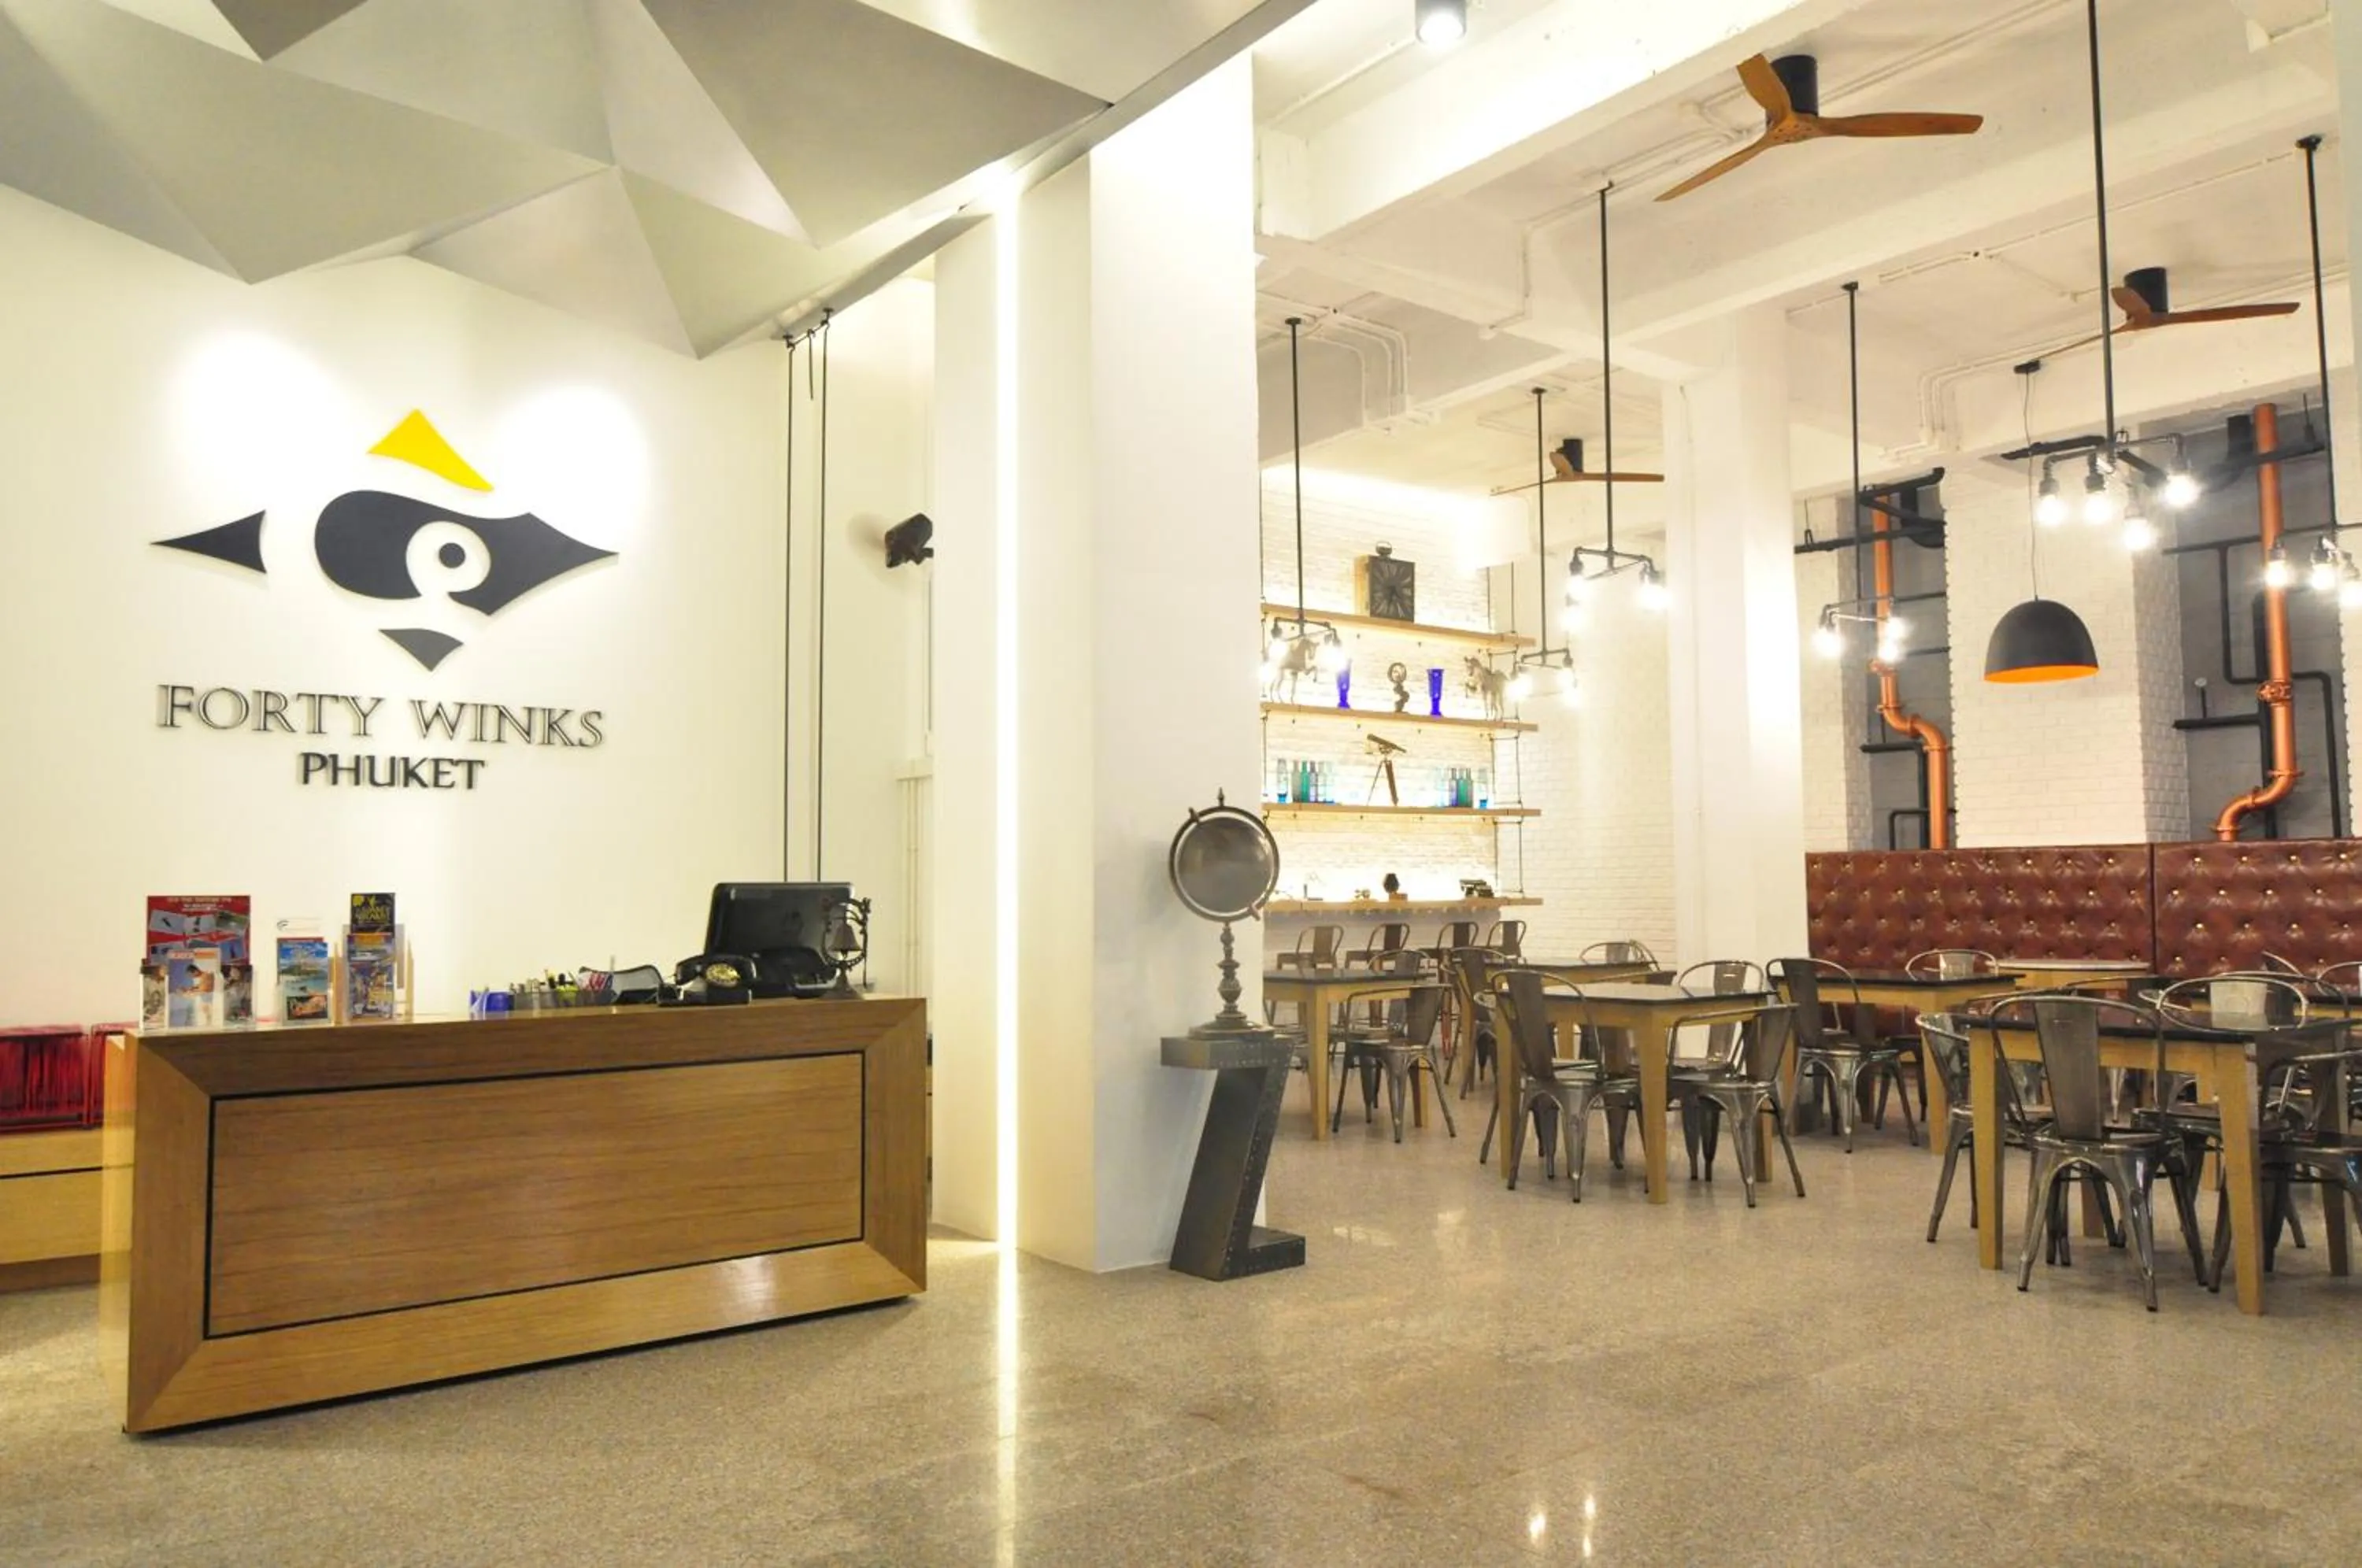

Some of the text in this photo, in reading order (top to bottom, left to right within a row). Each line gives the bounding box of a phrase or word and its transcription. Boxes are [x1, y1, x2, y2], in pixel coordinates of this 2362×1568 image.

[157, 684, 604, 747] FORTY WINKS
[301, 752, 485, 790] PHUKET
